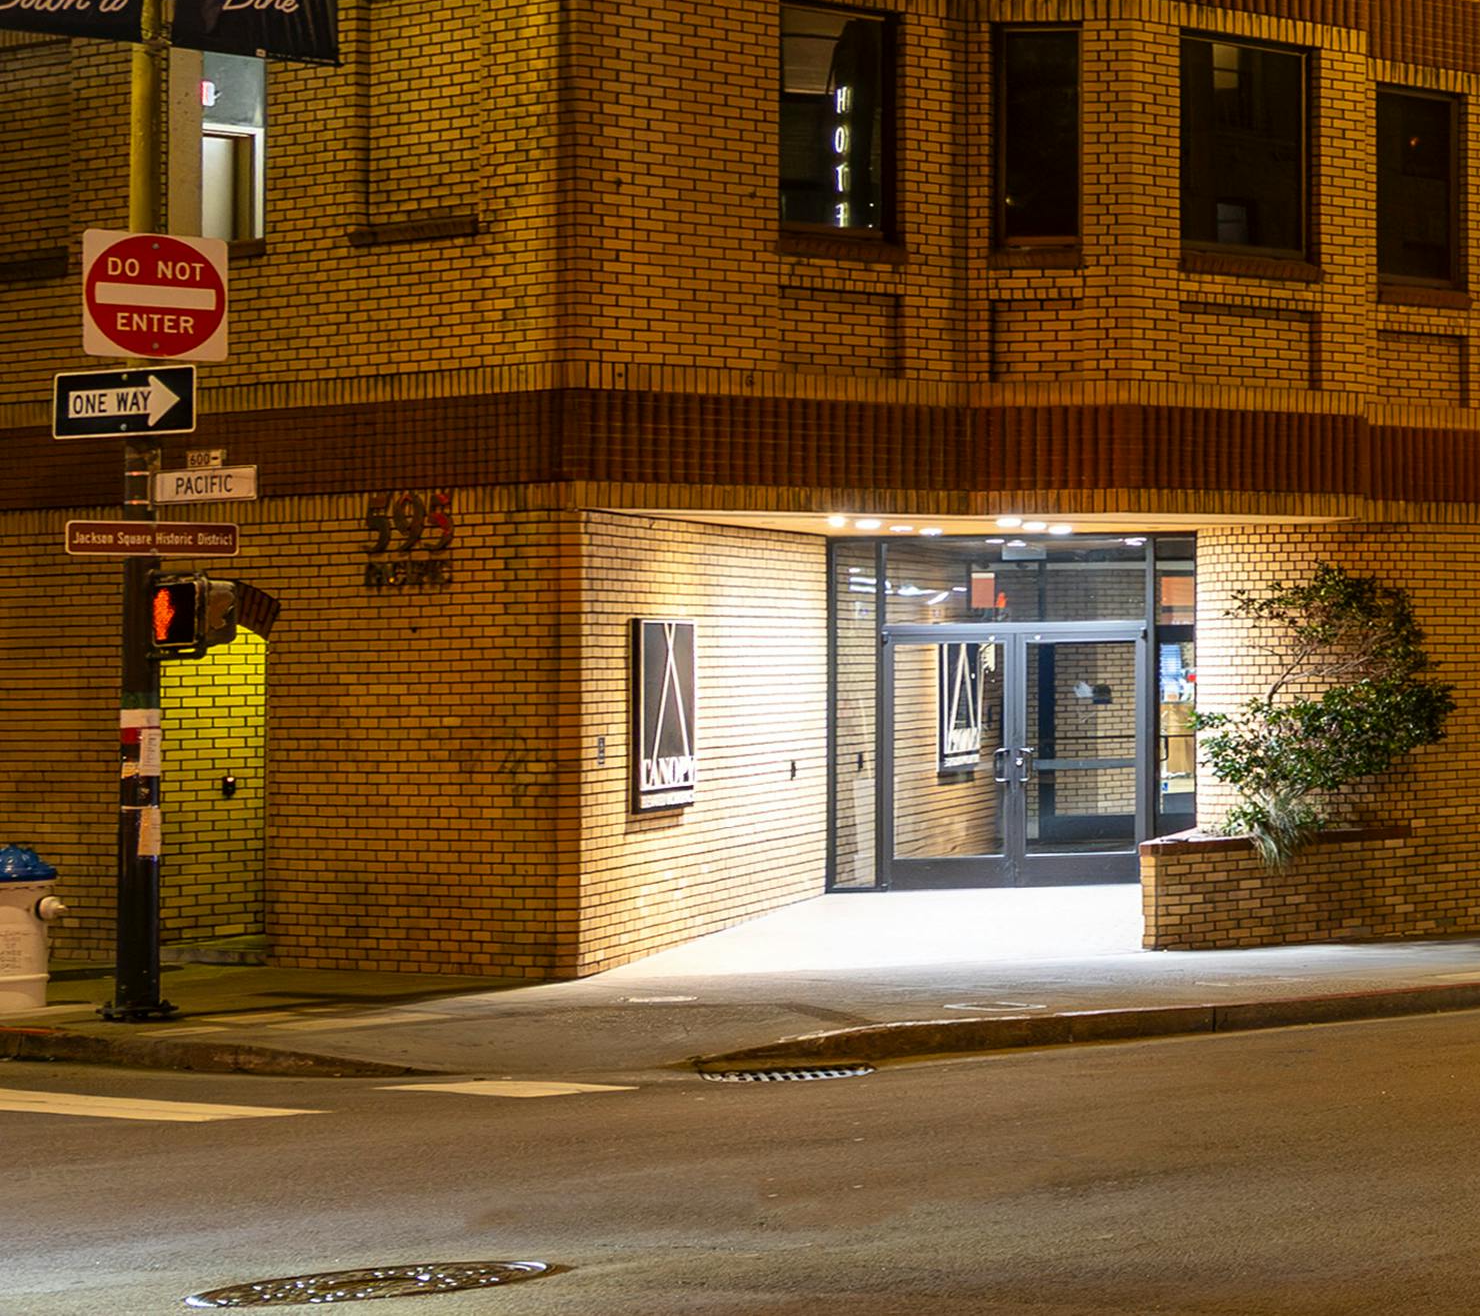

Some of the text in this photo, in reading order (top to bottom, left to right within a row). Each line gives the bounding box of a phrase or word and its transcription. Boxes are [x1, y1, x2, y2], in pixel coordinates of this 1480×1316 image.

[107, 256, 205, 282] DO NOT
[116, 312, 195, 335] ENTER
[73, 390, 151, 415] ONE WAY
[175, 475, 234, 496] PACIFIC
[73, 532, 233, 547] Jackson Square Historic District
